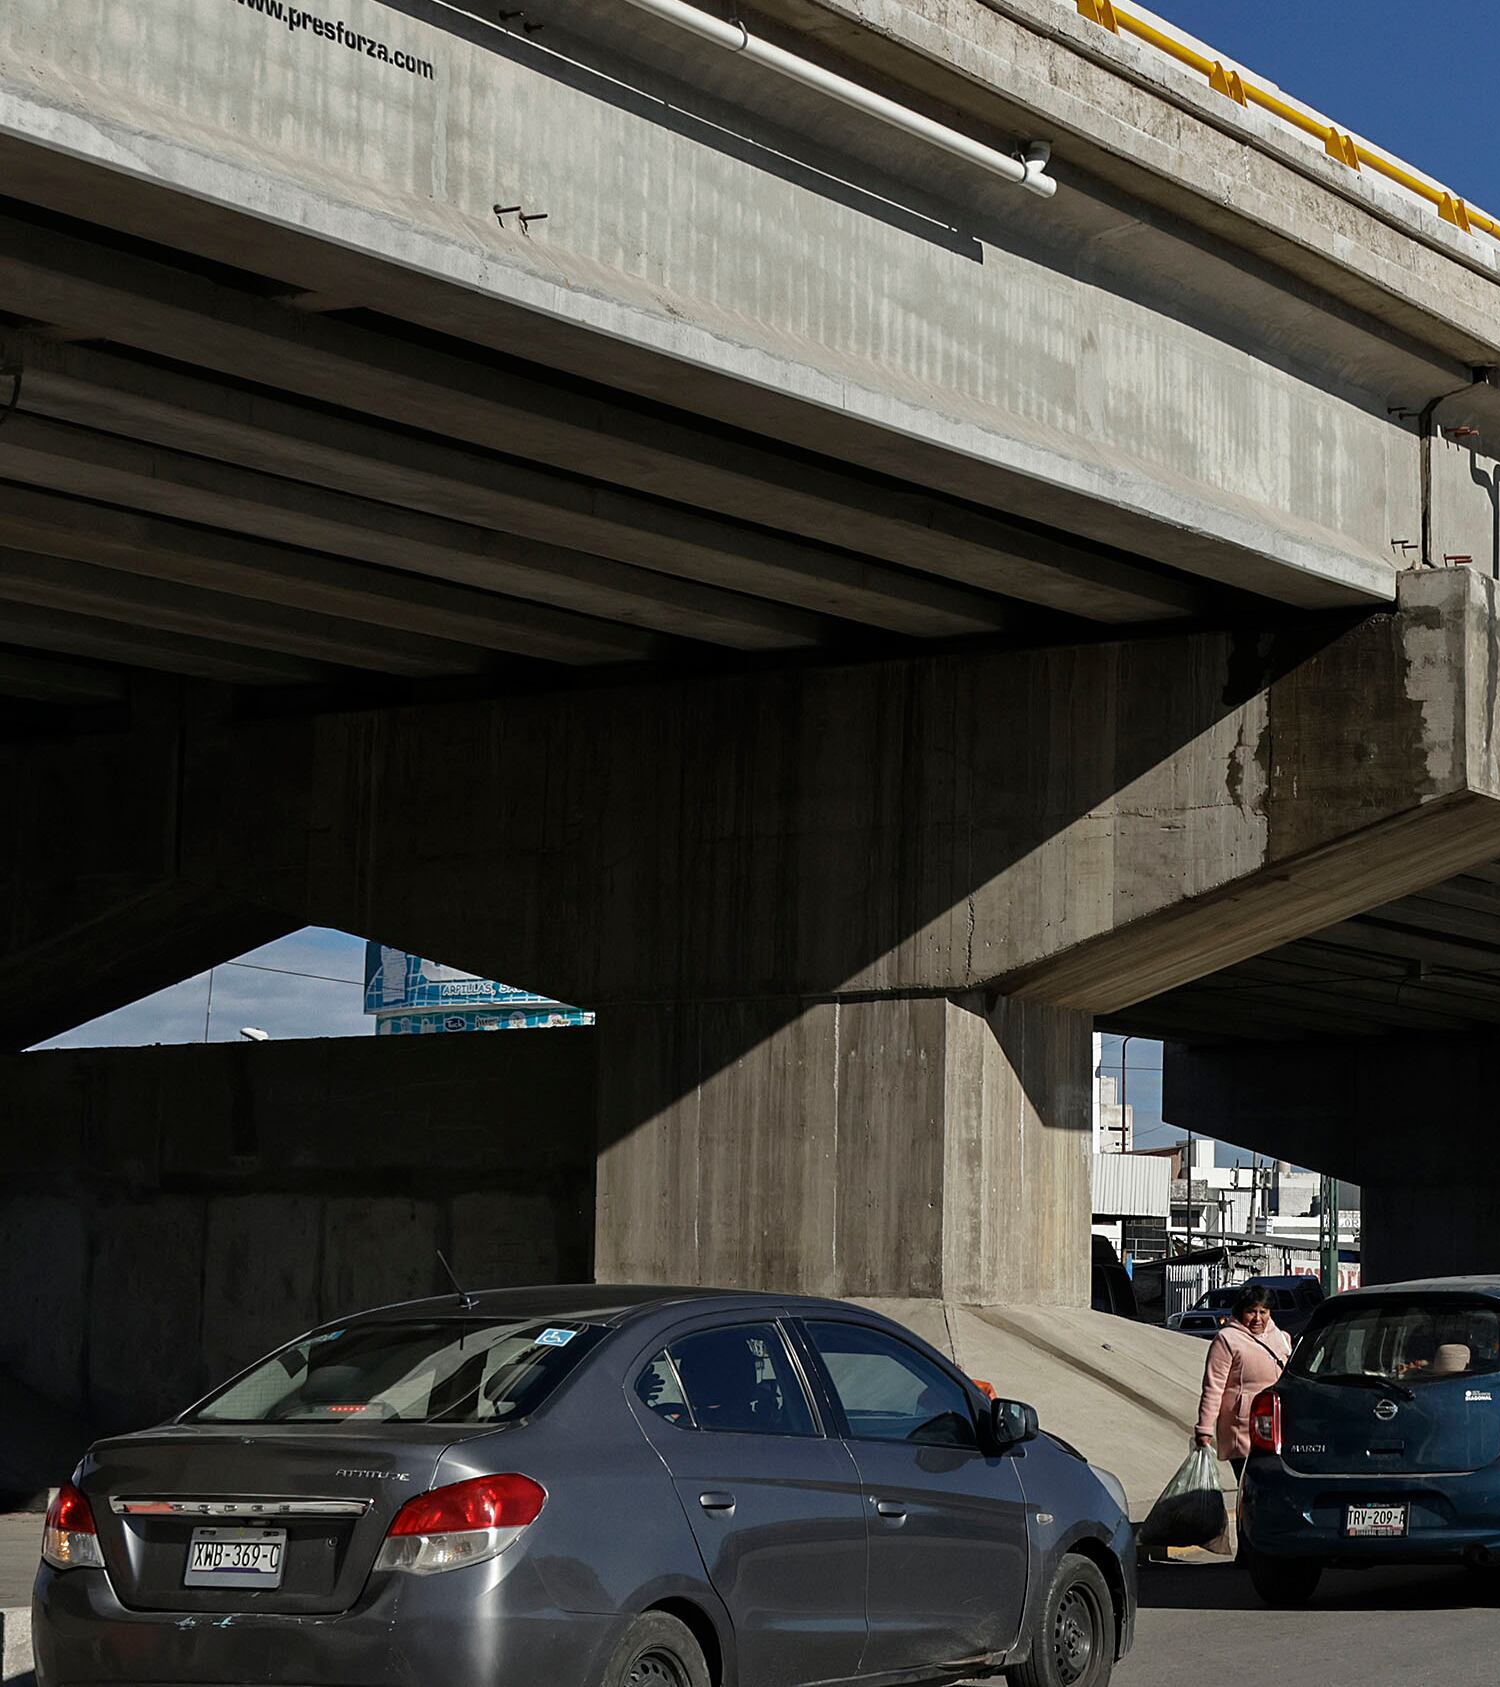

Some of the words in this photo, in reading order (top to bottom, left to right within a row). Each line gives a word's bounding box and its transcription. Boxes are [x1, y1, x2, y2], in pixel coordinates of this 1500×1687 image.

[1290, 1443, 1326, 1454] MARCH
[335, 1468, 411, 1483] ATTITUDE
[1347, 1510, 1405, 1526] TRV-209-A
[194, 1543, 280, 1569] XWB-369-C
